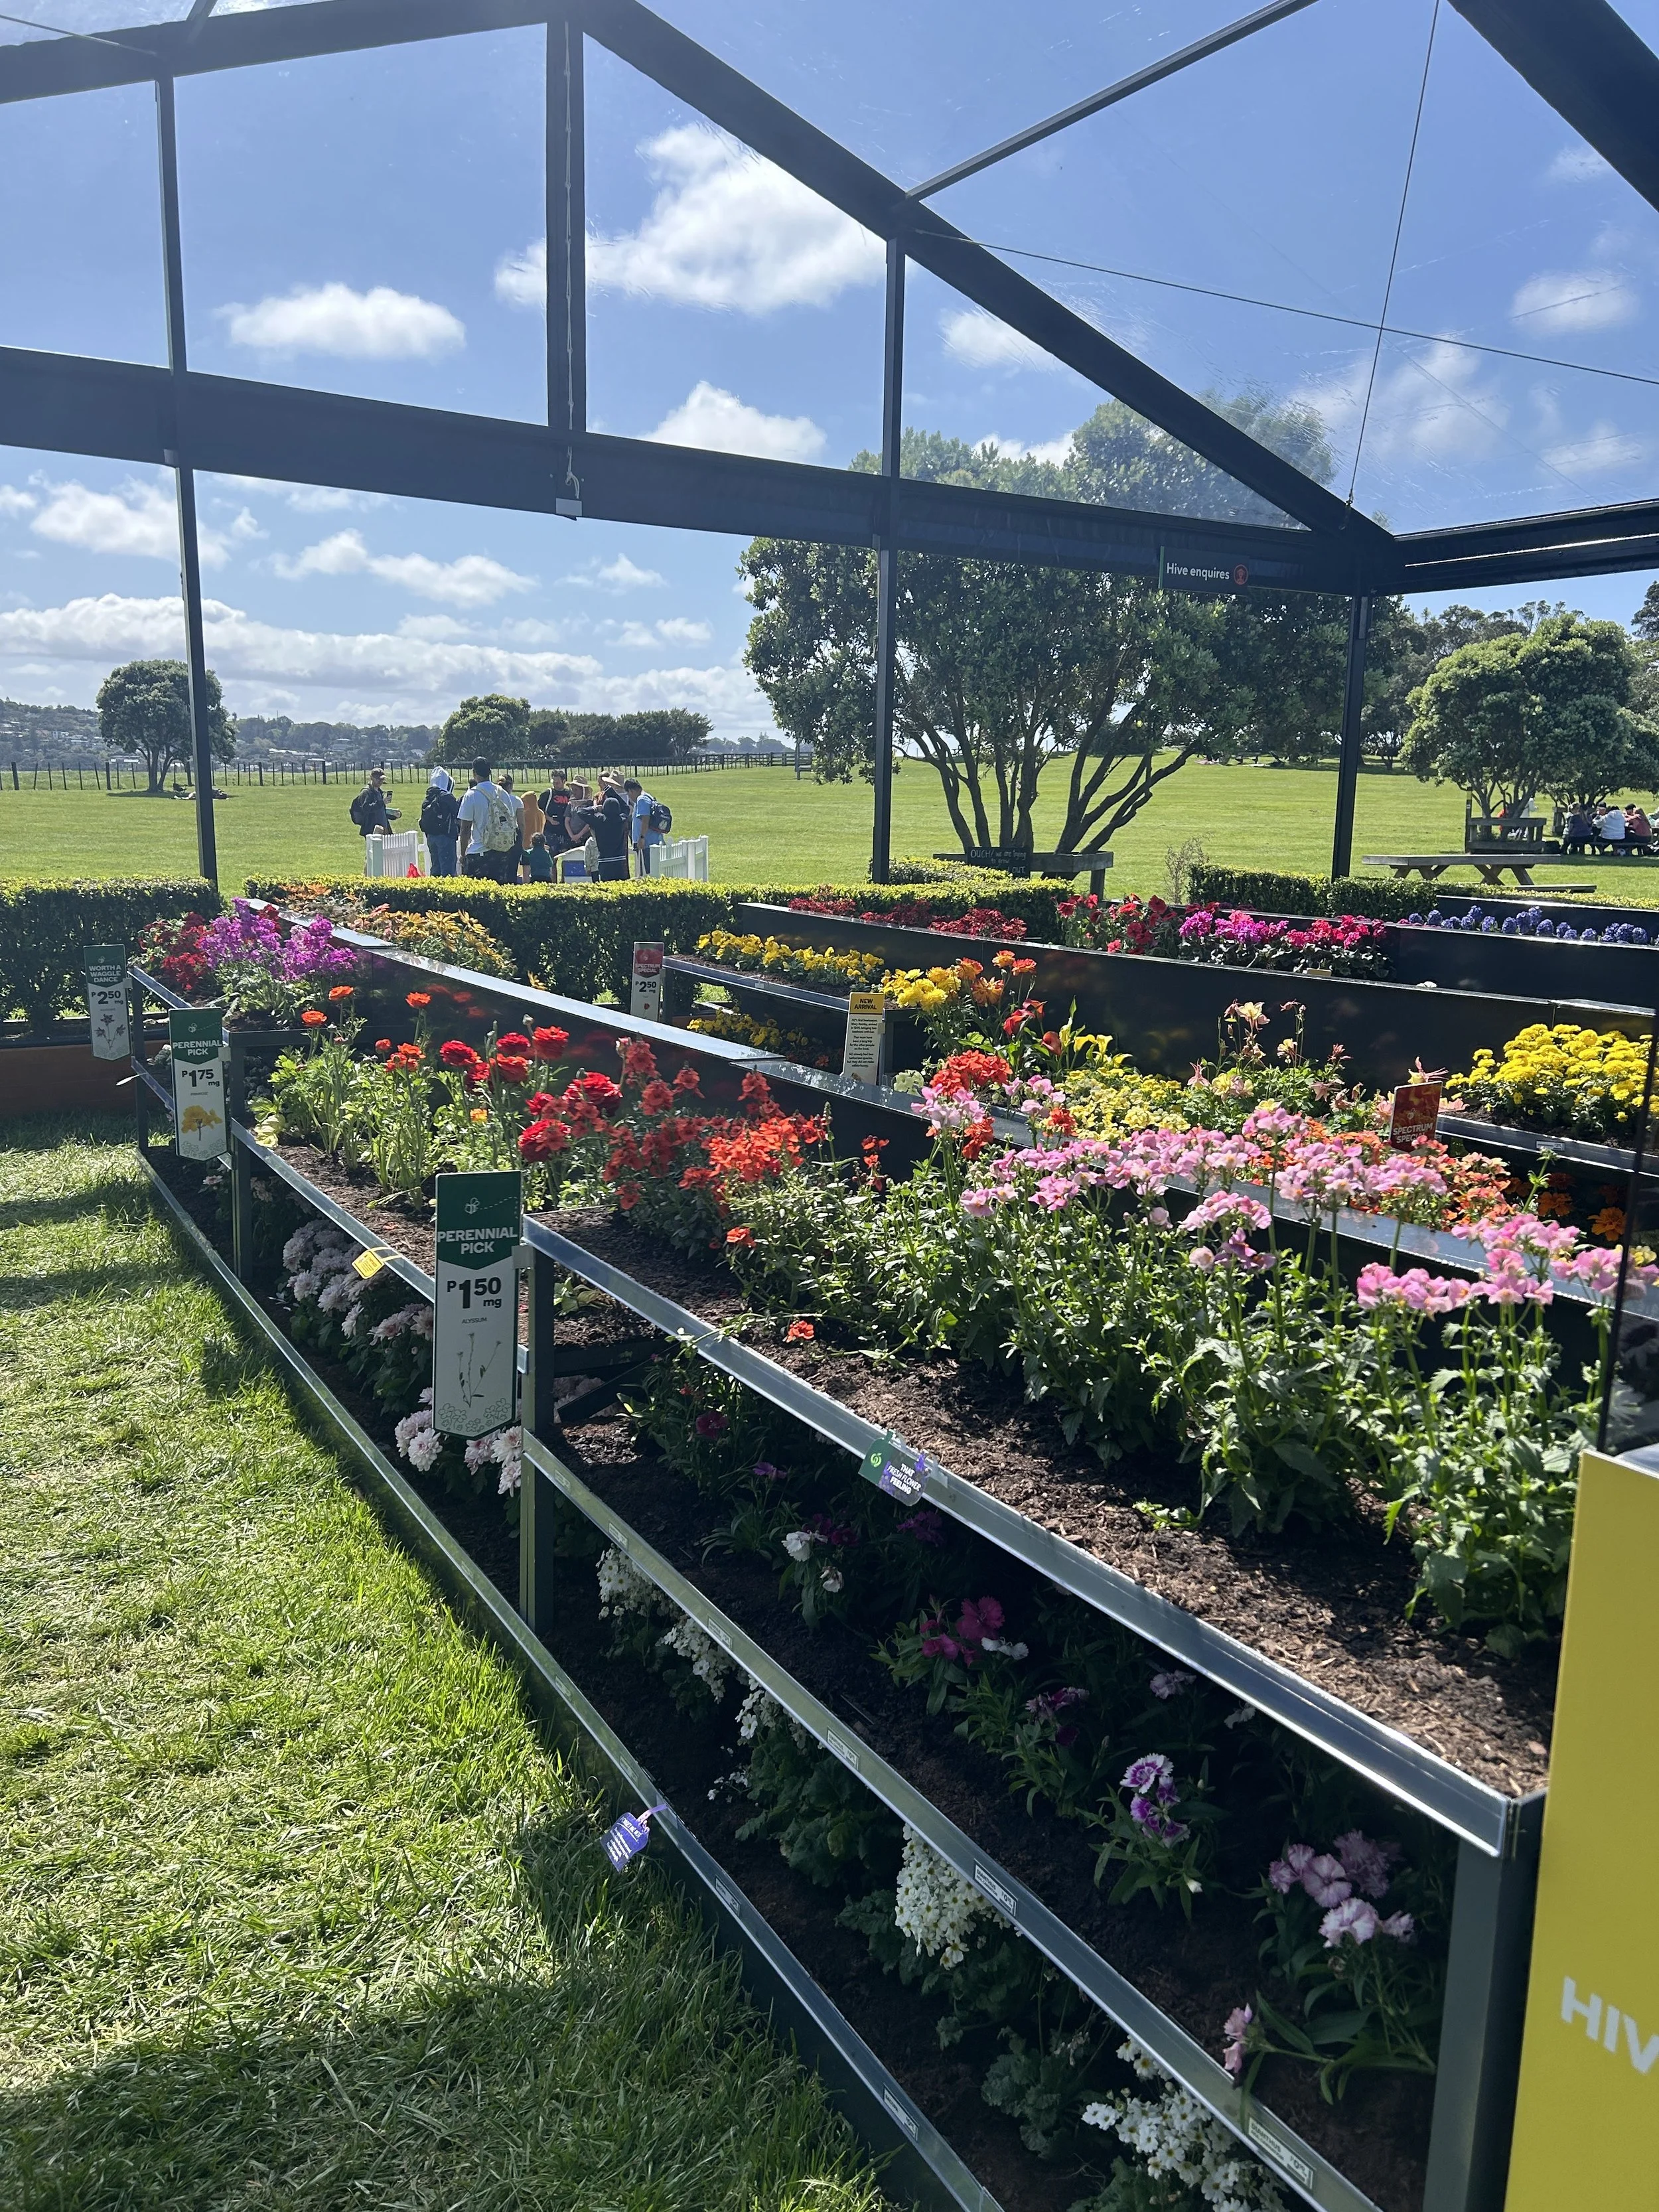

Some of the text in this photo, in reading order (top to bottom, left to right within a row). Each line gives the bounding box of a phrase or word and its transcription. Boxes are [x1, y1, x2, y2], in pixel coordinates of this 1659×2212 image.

[1167, 562, 1230, 581] Hive enquires
[173, 1040, 222, 1049] PERENNIAL
[1392, 1122, 1433, 1136] SPECTRUM
[437, 1226, 518, 1243] PERENNIAL
[461, 1241, 494, 1254] PICK
[483, 1298, 502, 1308] mg
[900, 1463, 915, 1477] THAT
[887, 1465, 921, 1491] FRESH FLOWER
[890, 1476, 912, 1495] FEELING
